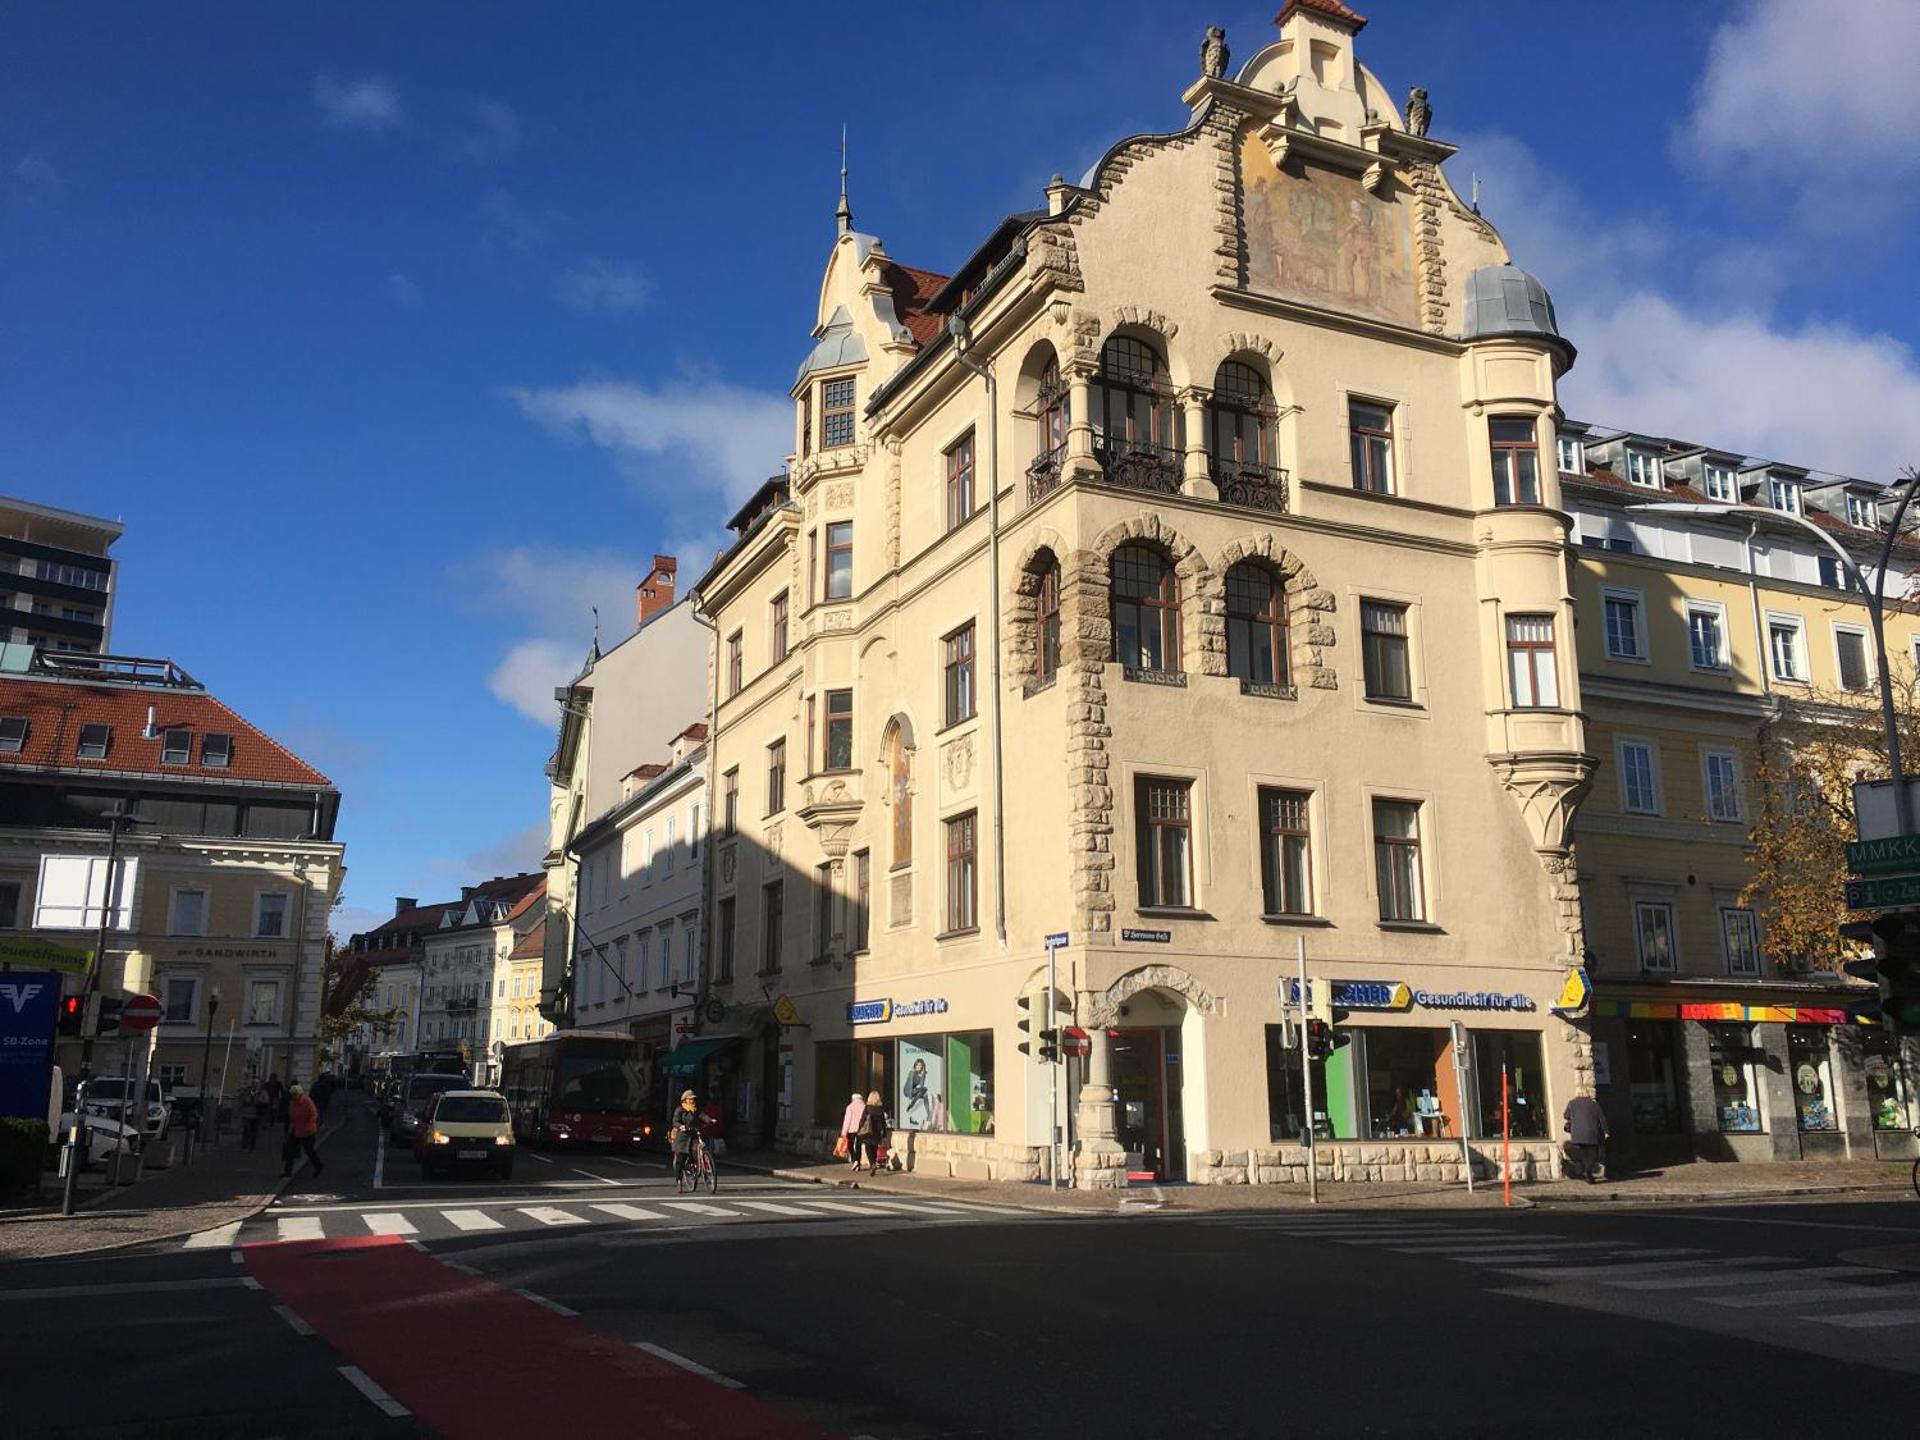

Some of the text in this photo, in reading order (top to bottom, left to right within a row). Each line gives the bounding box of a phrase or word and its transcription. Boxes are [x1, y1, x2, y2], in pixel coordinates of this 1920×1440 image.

[1851, 839, 1920, 861] MMKK
[0, 944, 85, 967] eueröffnung
[195, 947, 278, 958] SANDWIRTH
[1416, 990, 1534, 1010] Gesundheit für alle
[2, 1035, 49, 1047] SB-Zone
